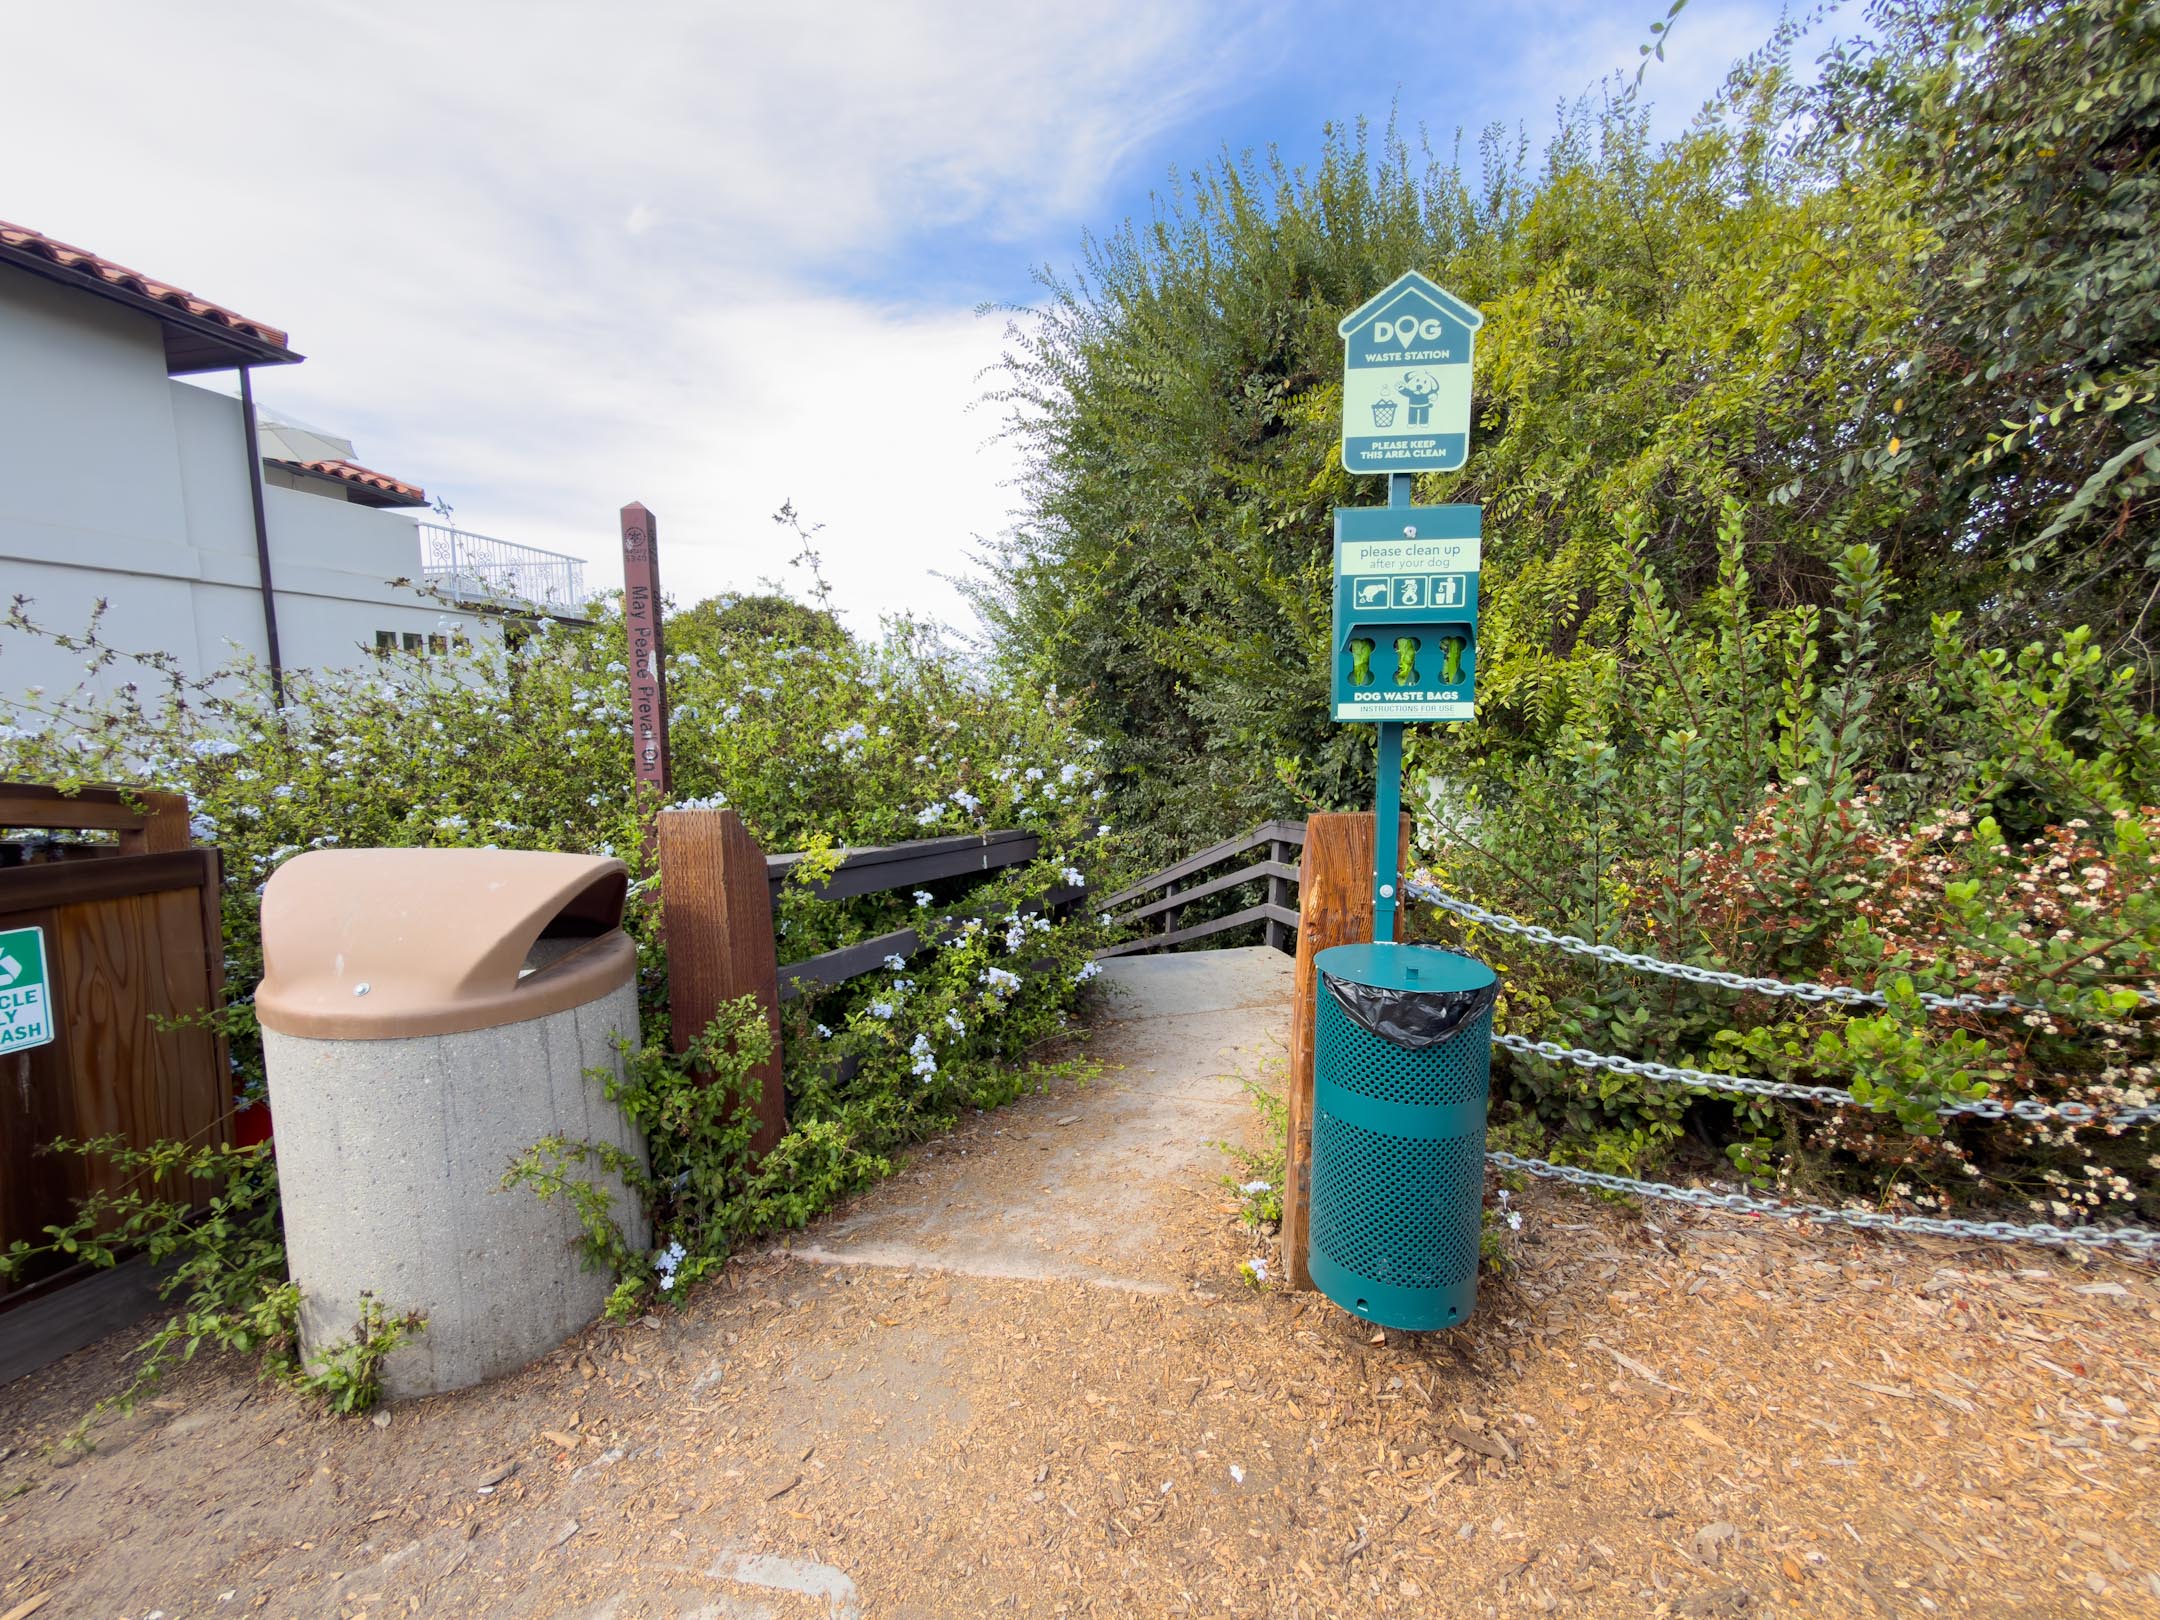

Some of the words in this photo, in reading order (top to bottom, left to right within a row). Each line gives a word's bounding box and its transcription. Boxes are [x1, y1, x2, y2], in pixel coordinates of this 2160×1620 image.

[1374, 315, 1441, 349] DOG
[1365, 352, 1401, 362] WASTE
[1405, 350, 1449, 360] STATION
[1372, 441, 1407, 450] PLEASE
[1411, 440, 1436, 448] KEEP
[1360, 451, 1382, 459] THIS
[1385, 450, 1411, 458] AREA
[1413, 449, 1446, 457] CLEAN
[1360, 545, 1401, 559] please
[1405, 544, 1440, 556] clean
[1444, 546, 1460, 556] up
[1370, 559, 1394, 569] after
[1400, 559, 1423, 569] your
[1428, 557, 1450, 568] dog
[631, 586, 648, 620] May
[635, 627, 651, 678] Peace
[1354, 692, 1381, 701] DOG
[1384, 692, 1424, 701] WASTE
[1427, 691, 1459, 700] BAGS
[638, 686, 657, 740] Prevail
[641, 749, 658, 771] On
